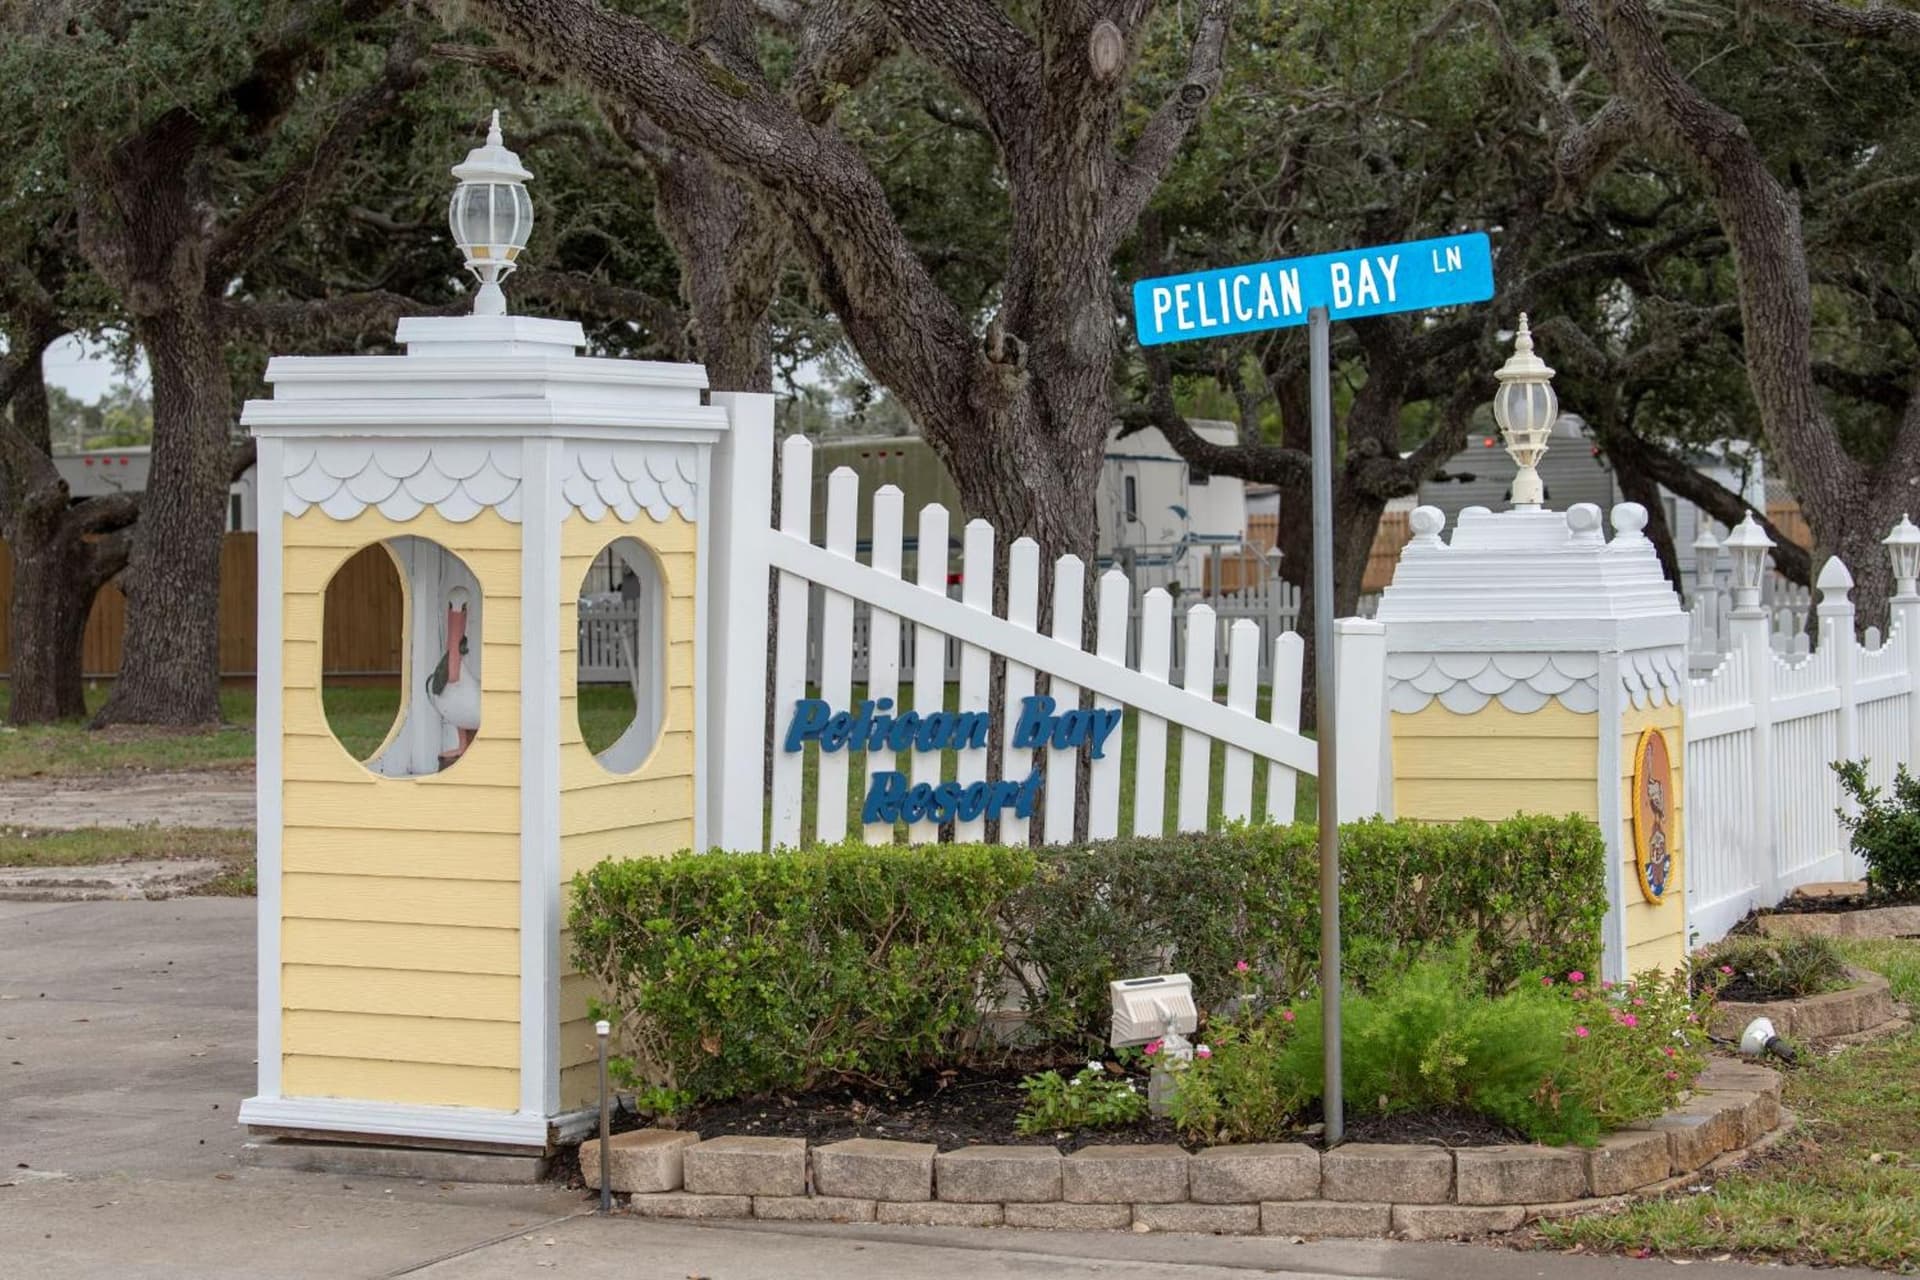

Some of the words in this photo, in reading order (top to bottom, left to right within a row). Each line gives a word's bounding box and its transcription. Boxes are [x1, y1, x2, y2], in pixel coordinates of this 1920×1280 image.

[1152, 268, 1303, 334] PELICAN
[1330, 254, 1400, 310] BAY
[1432, 245, 1463, 274] LN
[784, 697, 990, 753] Pelican
[1012, 695, 1122, 760] Bay
[861, 766, 1044, 825] Resort
